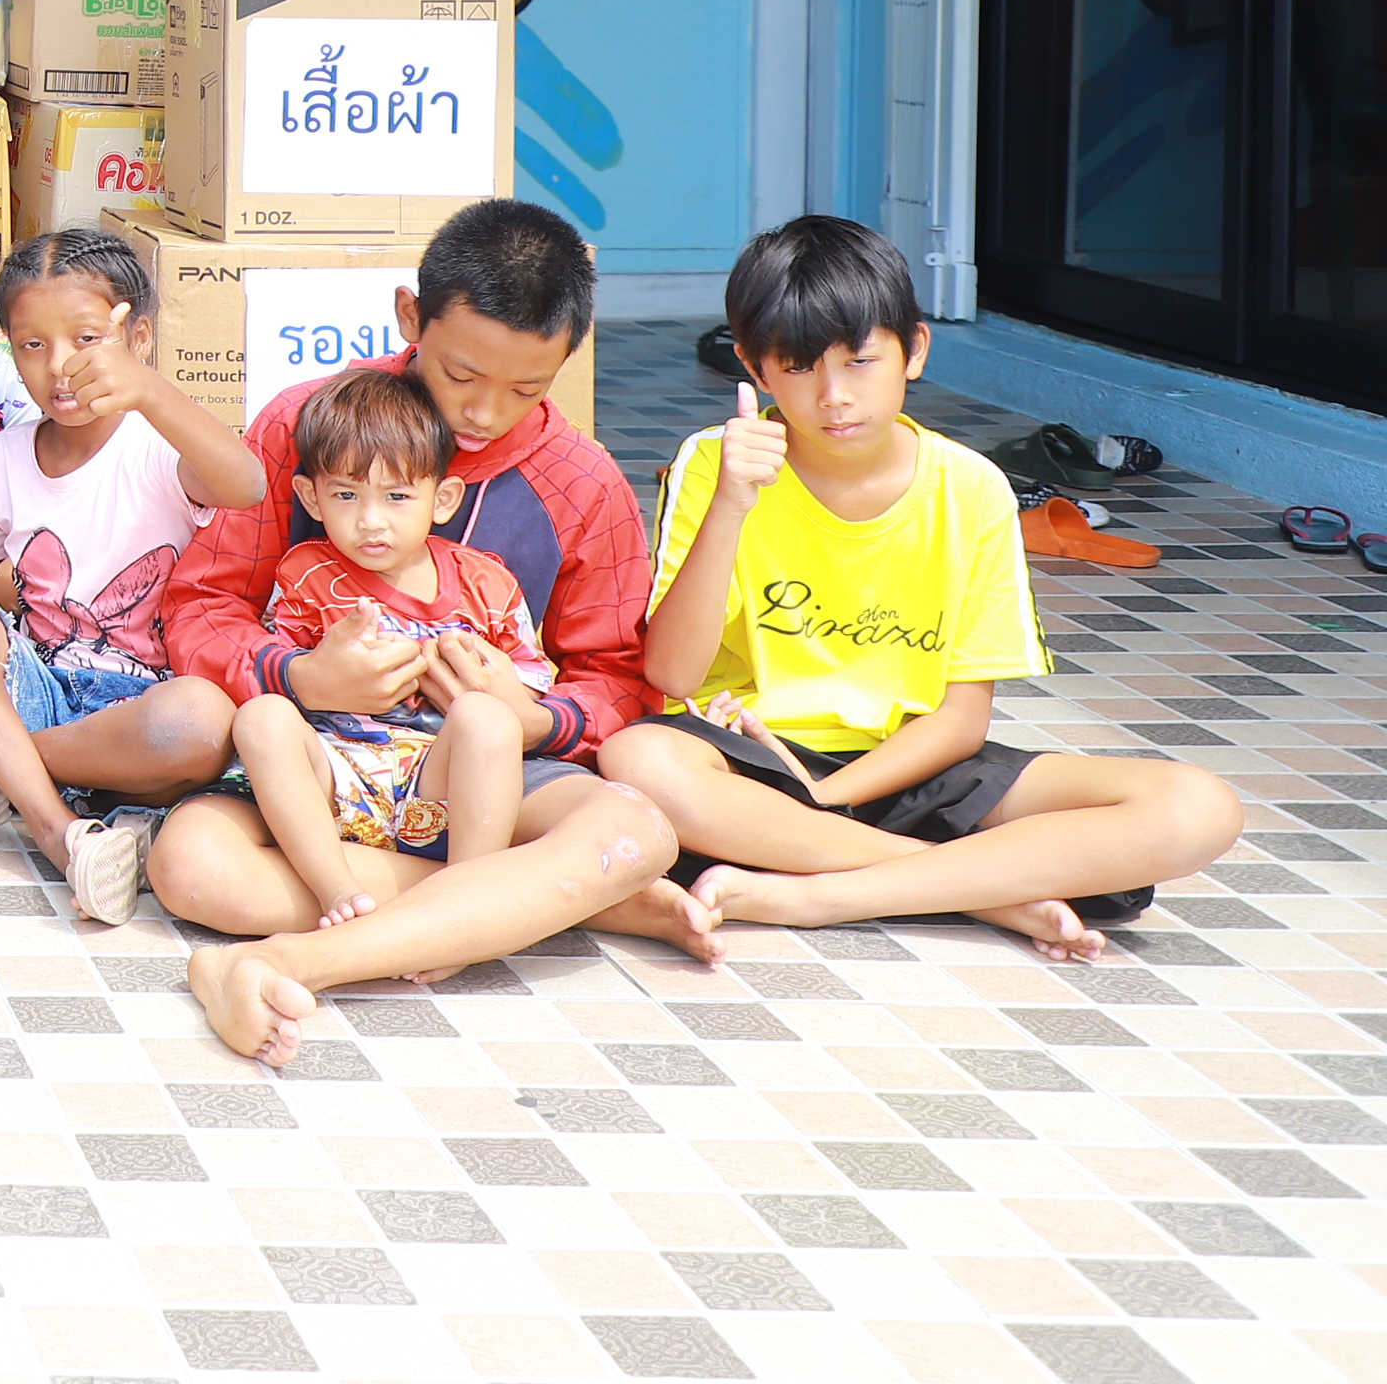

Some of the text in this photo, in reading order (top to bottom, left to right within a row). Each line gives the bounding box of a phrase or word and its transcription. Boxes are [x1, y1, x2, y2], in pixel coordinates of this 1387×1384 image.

[282, 43, 459, 134] เสื้อผ้า
[240, 211, 297, 225] 1 DOZ.
[176, 348, 221, 362] Toner
[176, 369, 246, 383] Cartouch
[208, 393, 227, 404] box
